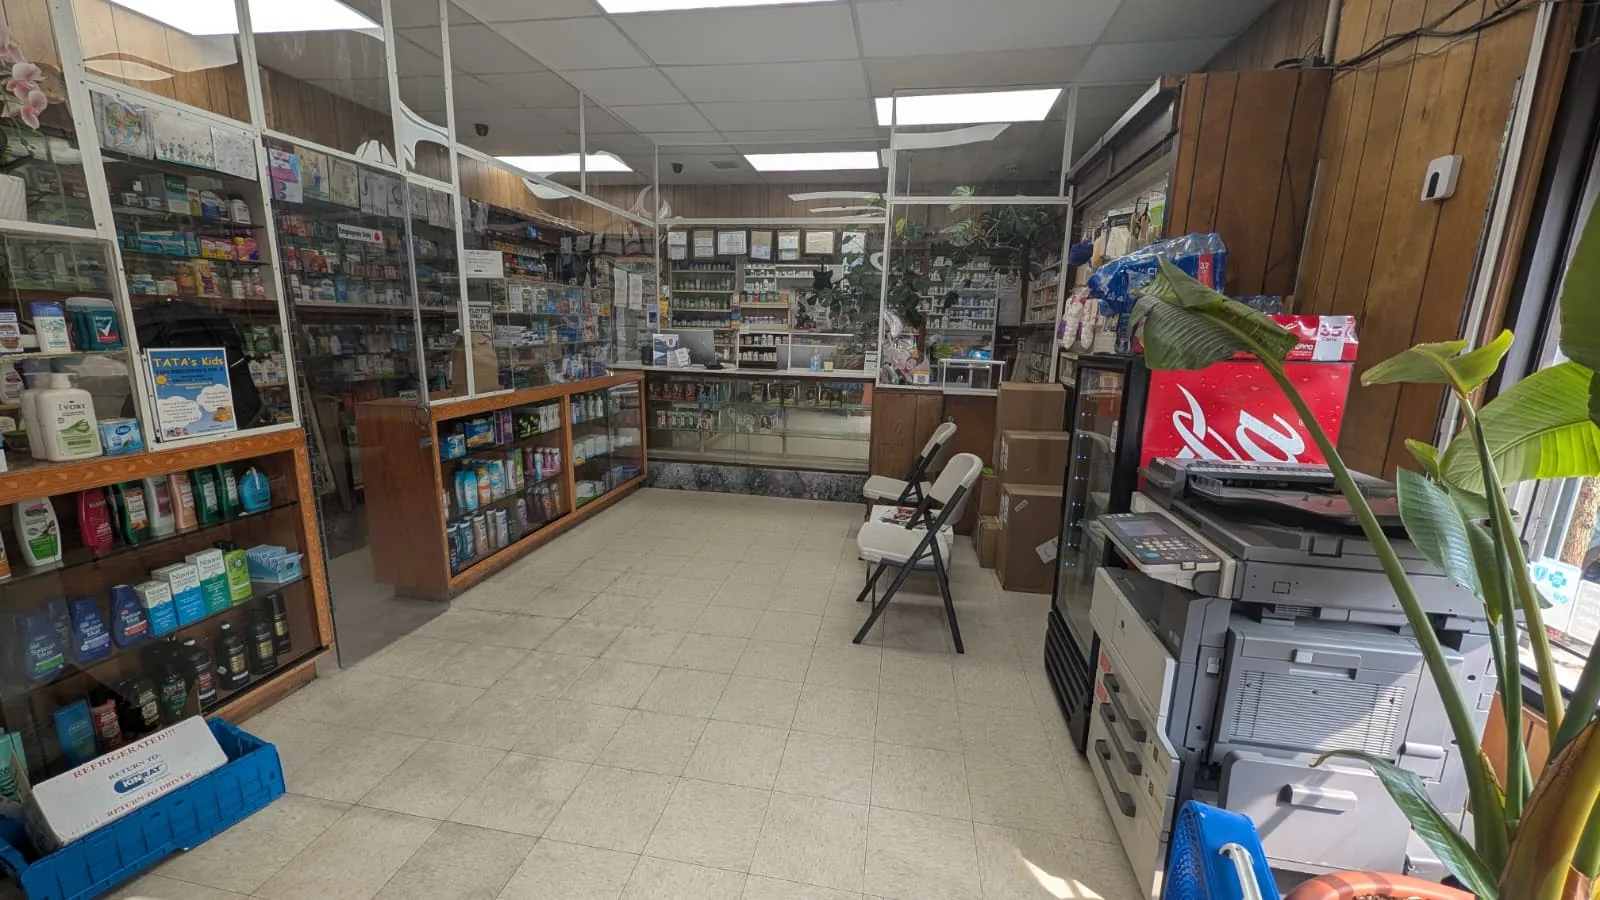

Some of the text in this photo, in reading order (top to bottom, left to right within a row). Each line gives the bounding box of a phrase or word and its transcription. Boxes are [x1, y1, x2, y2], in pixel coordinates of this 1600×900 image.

[1320, 324, 1342, 337] 35
[152, 355, 224, 368] TATA's Kids
[57, 403, 87, 411] IVORY
[72, 728, 177, 779] REFRIGERATED!!!
[108, 760, 146, 780] RETURN
[122, 764, 162, 788] KINRAY
[106, 796, 145, 818] RETURN
[145, 788, 159, 799] TO
[159, 771, 193, 792] DRIVER
